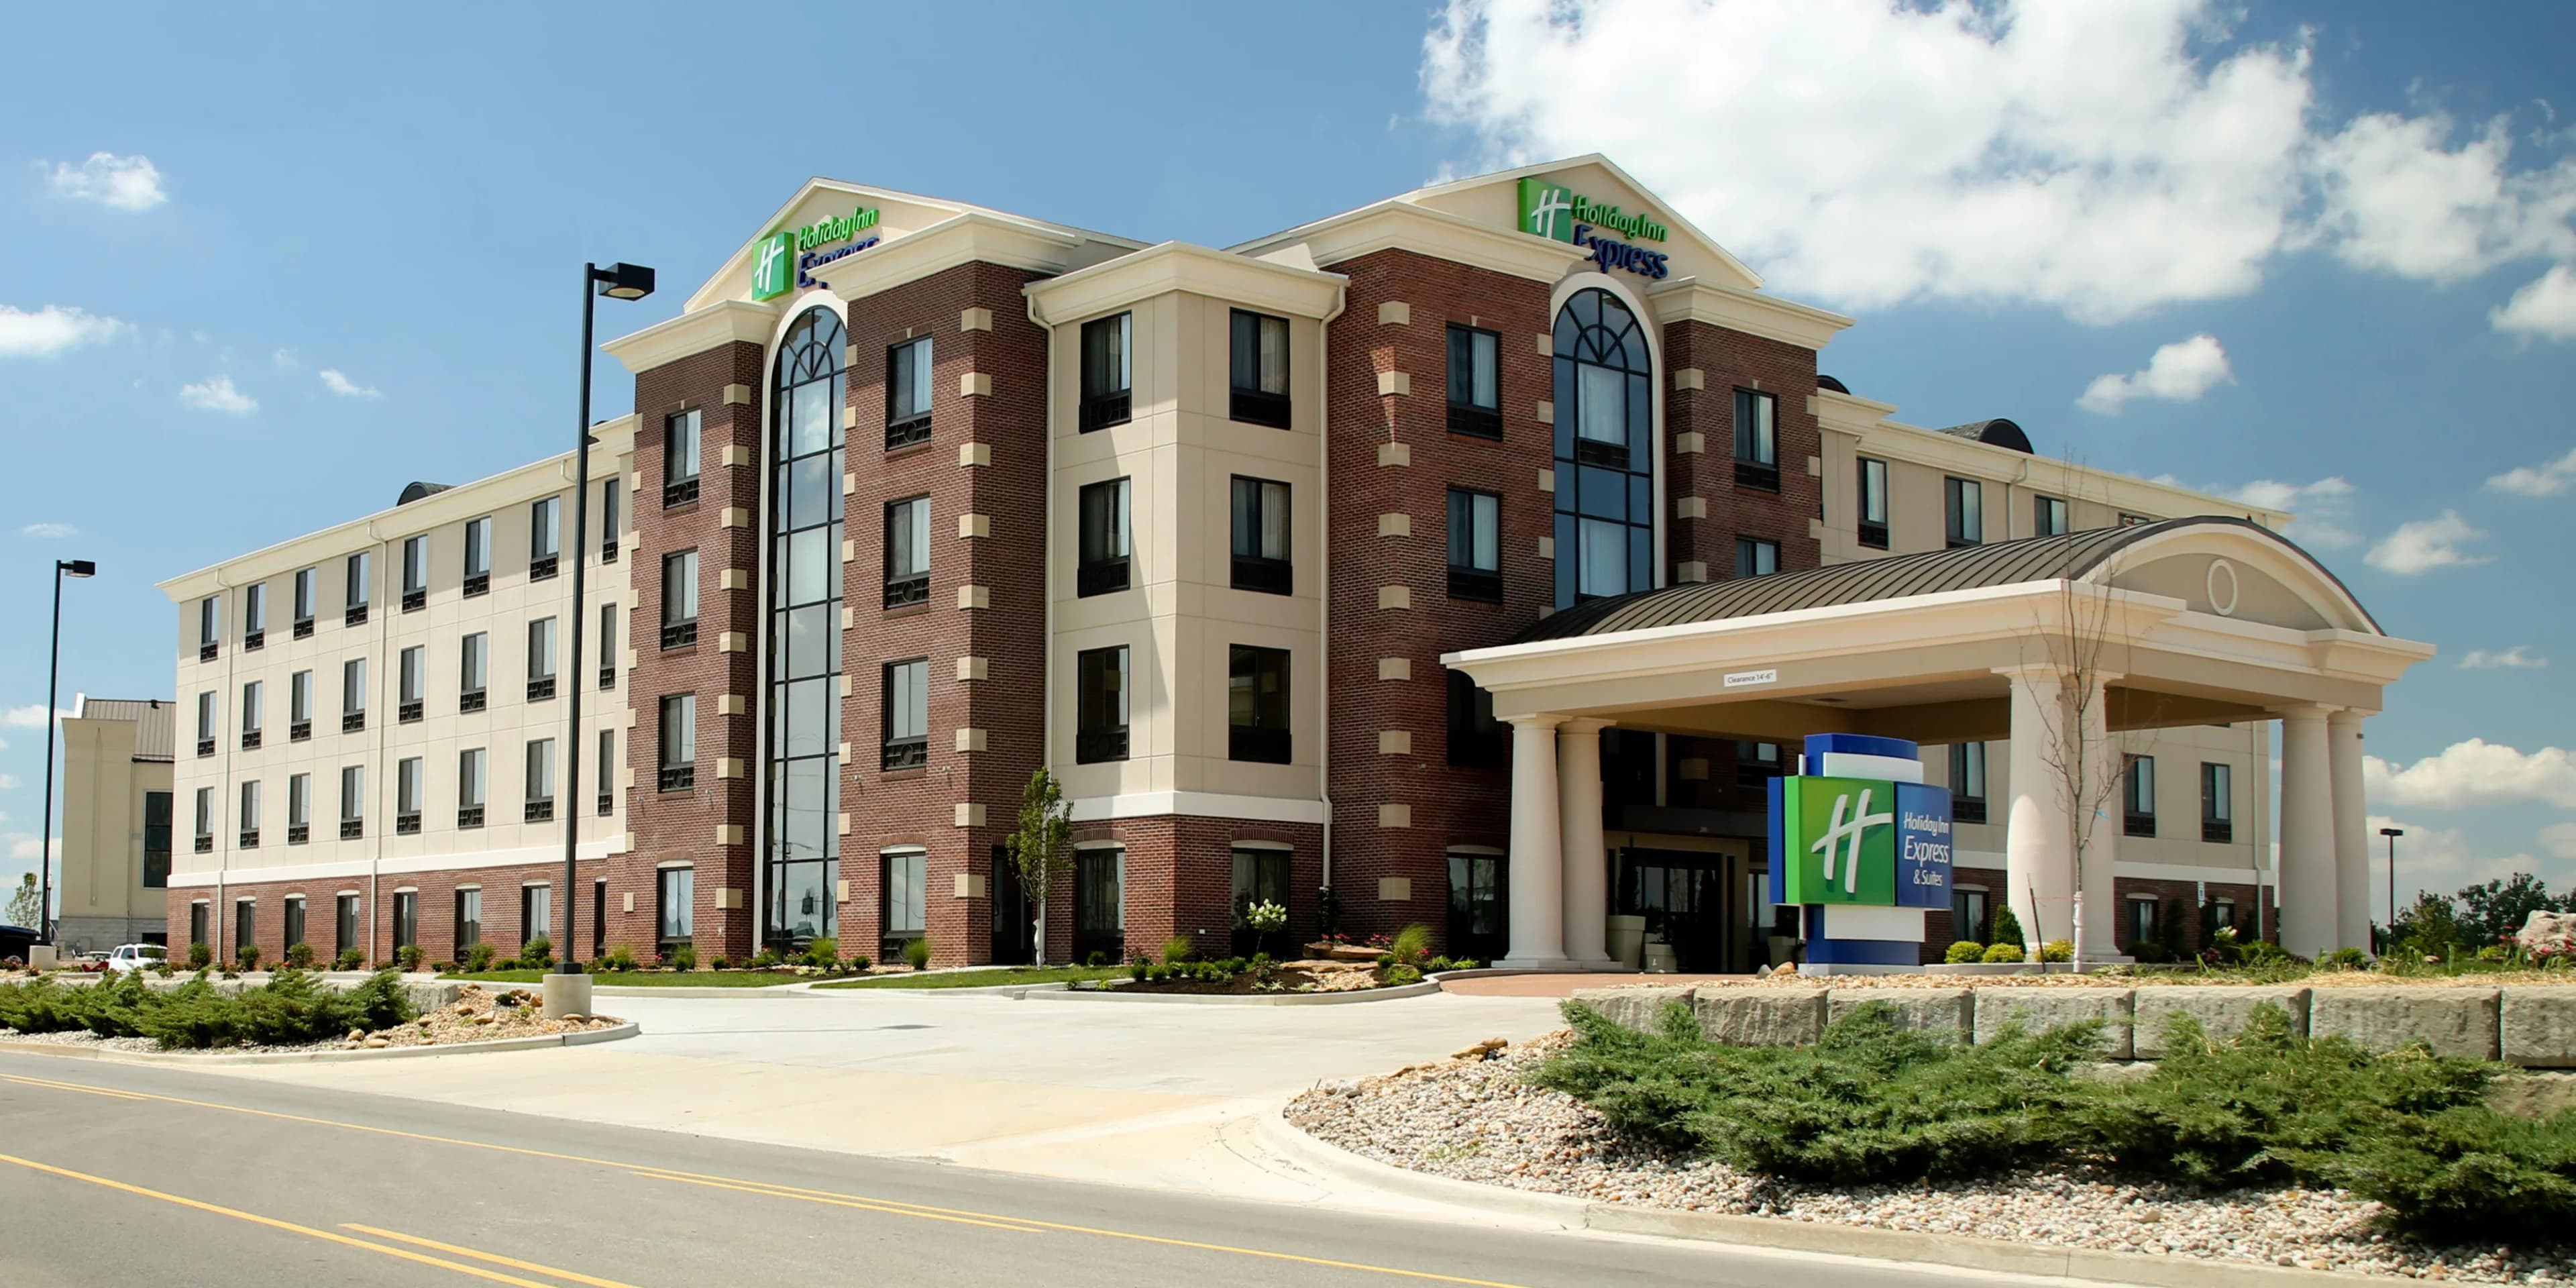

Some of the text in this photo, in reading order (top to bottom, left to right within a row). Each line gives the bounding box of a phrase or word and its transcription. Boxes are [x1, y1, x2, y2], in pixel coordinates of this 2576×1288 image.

[799, 207, 879, 251] Holiday Inn
[1573, 195, 1668, 242] Holiday Inn
[1573, 224, 1668, 278] Express
[1727, 676, 1756, 684] Clearance
[1904, 812, 1949, 837] Holiday Inn
[1904, 835, 1949, 867] Express
[1913, 869, 1943, 886] & Suites
